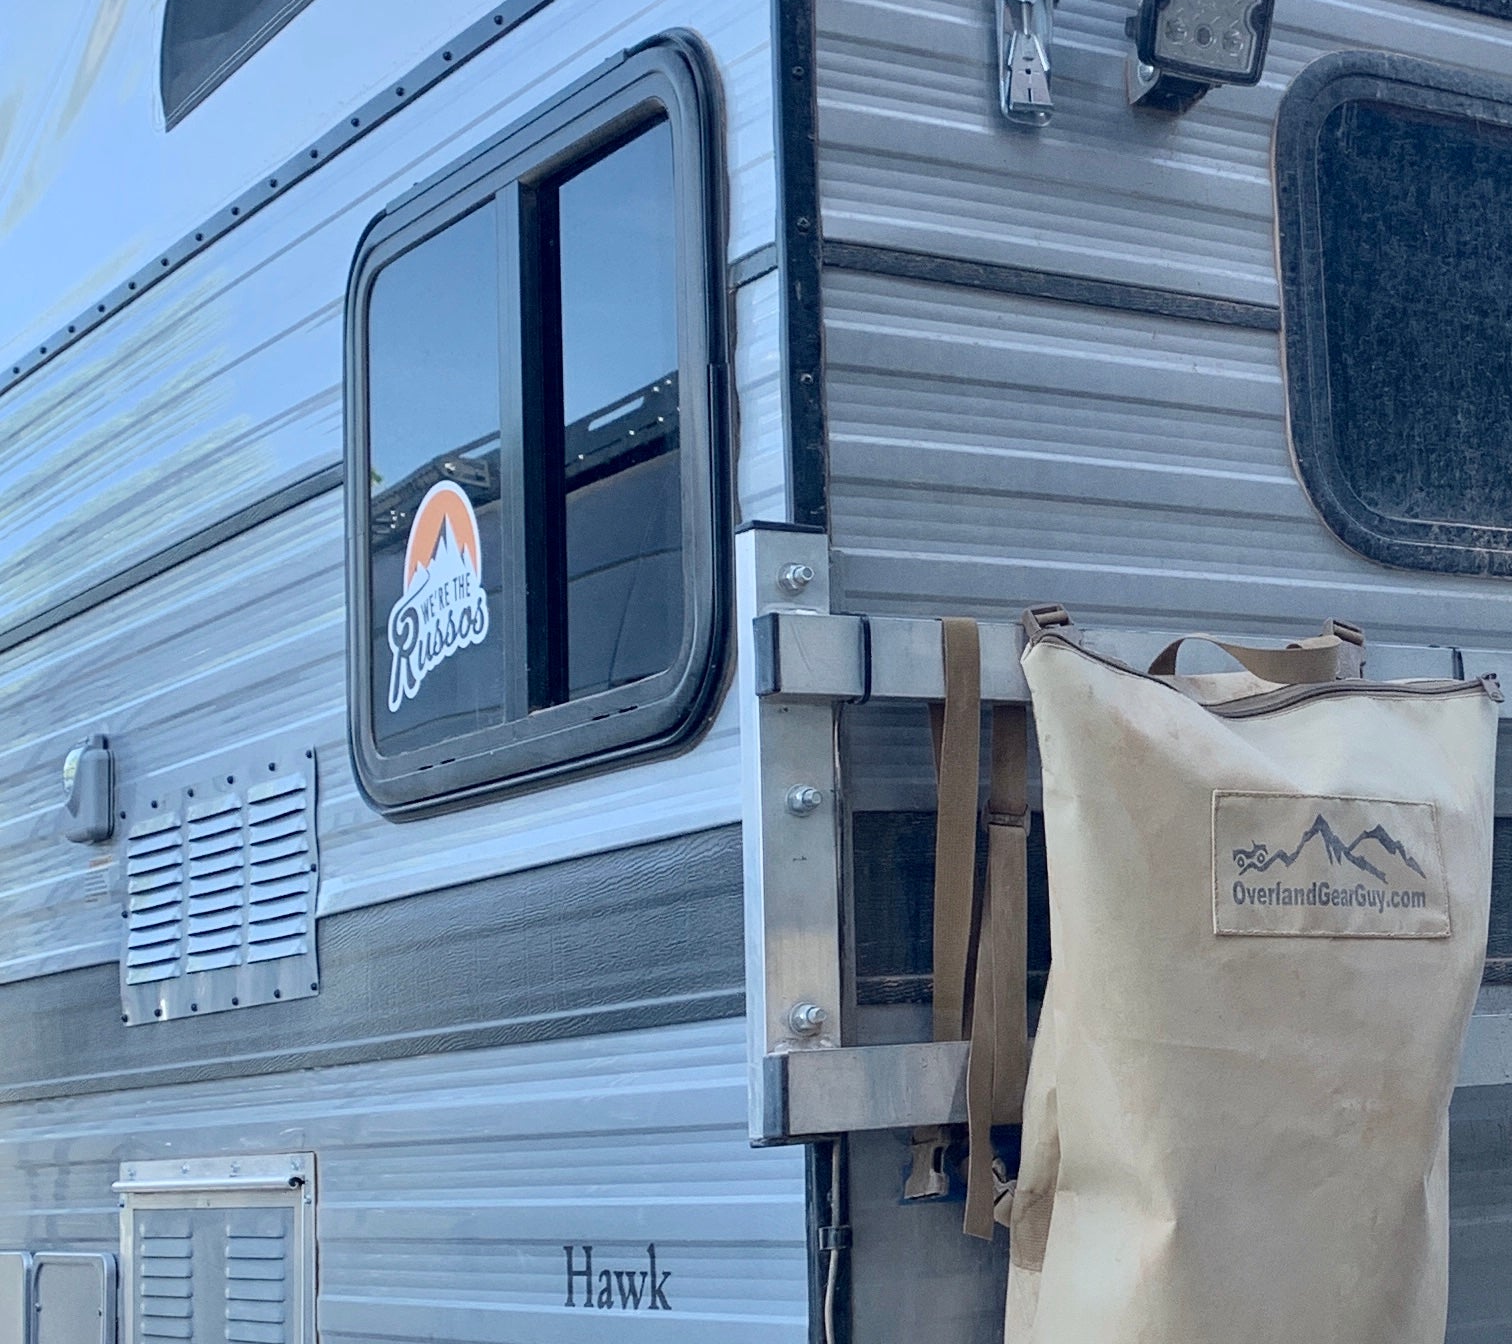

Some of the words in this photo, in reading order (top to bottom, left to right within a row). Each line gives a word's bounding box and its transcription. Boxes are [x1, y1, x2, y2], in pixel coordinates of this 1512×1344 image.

[419, 586, 450, 626] WE'RE
[453, 572, 471, 603] THE
[391, 597, 486, 705] Russos
[1232, 880, 1427, 914] OverlandGearGuy.com
[563, 1242, 673, 1311] Hawk
